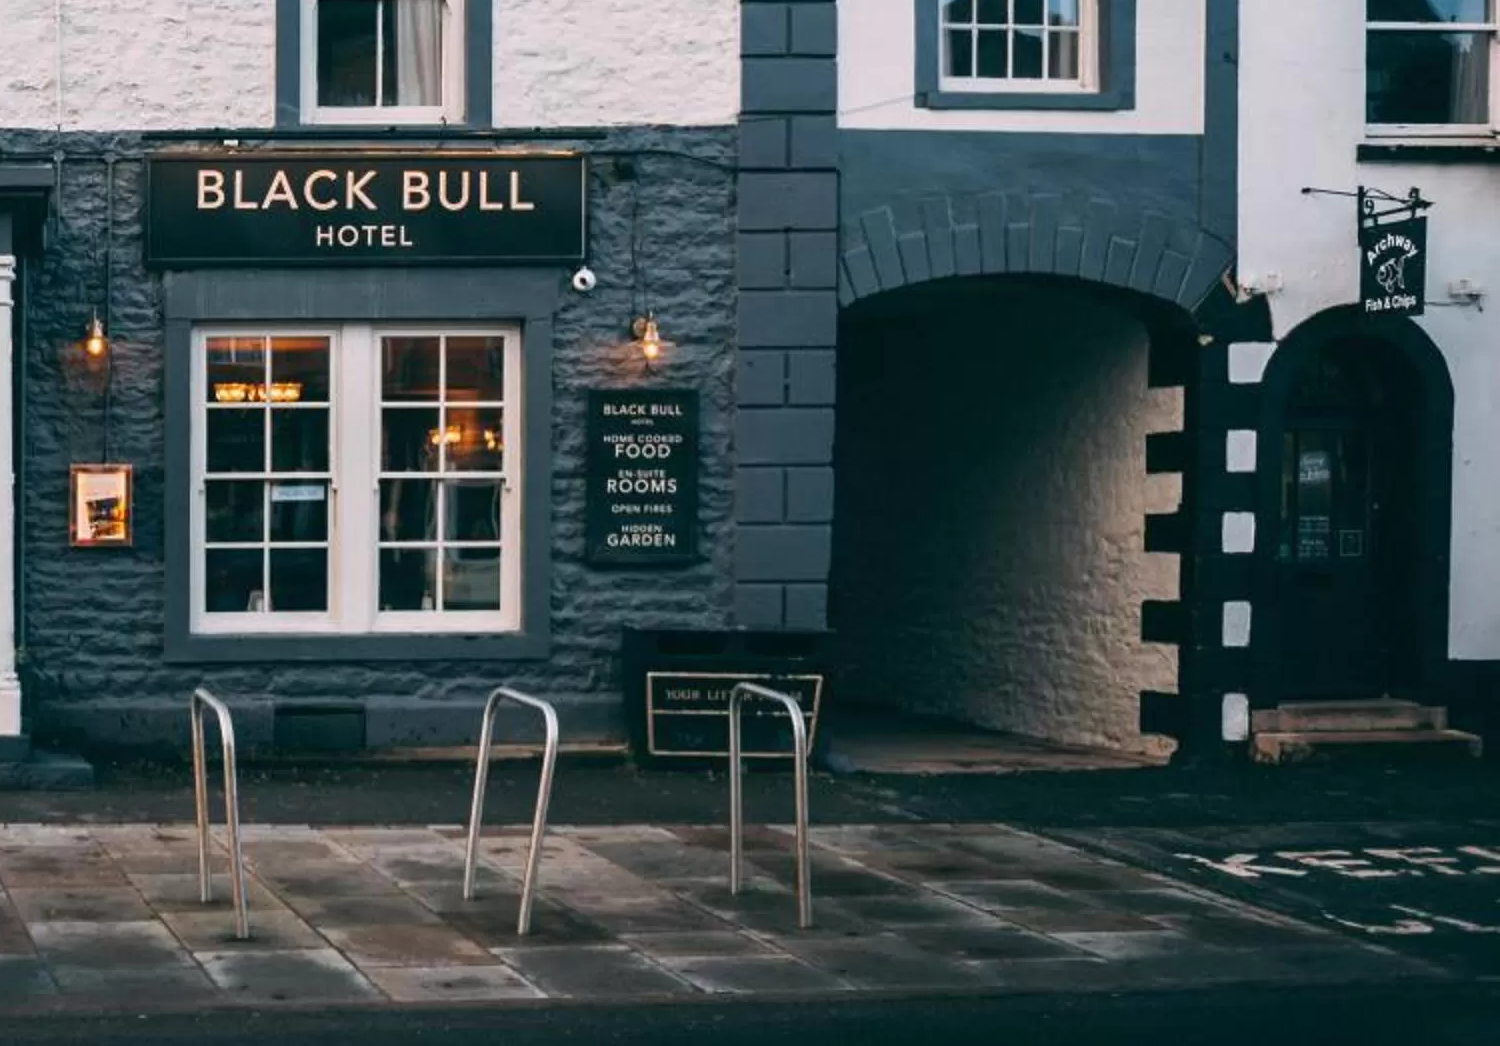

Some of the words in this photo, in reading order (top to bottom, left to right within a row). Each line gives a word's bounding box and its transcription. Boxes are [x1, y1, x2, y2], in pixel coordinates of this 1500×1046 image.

[197, 169, 378, 211] BLACK
[403, 170, 535, 211] BULL
[316, 225, 413, 247] HOTEL
[1367, 233, 1418, 266] Archway
[1365, 299, 1382, 312] Fish
[1384, 296, 1391, 309] &
[1391, 295, 1417, 311] Chips
[603, 404, 646, 416] BLACK
[651, 404, 683, 416] BULL
[603, 434, 634, 443] HOME
[637, 434, 683, 443] COOKED
[615, 443, 671, 458] FOOD
[618, 469, 666, 479] EN-SUITE
[607, 479, 677, 493] ROOMS
[611, 504, 641, 514] OPEN
[643, 504, 673, 514] FIRES
[621, 524, 663, 533] HIDDEN
[607, 533, 675, 547] GARDEN
